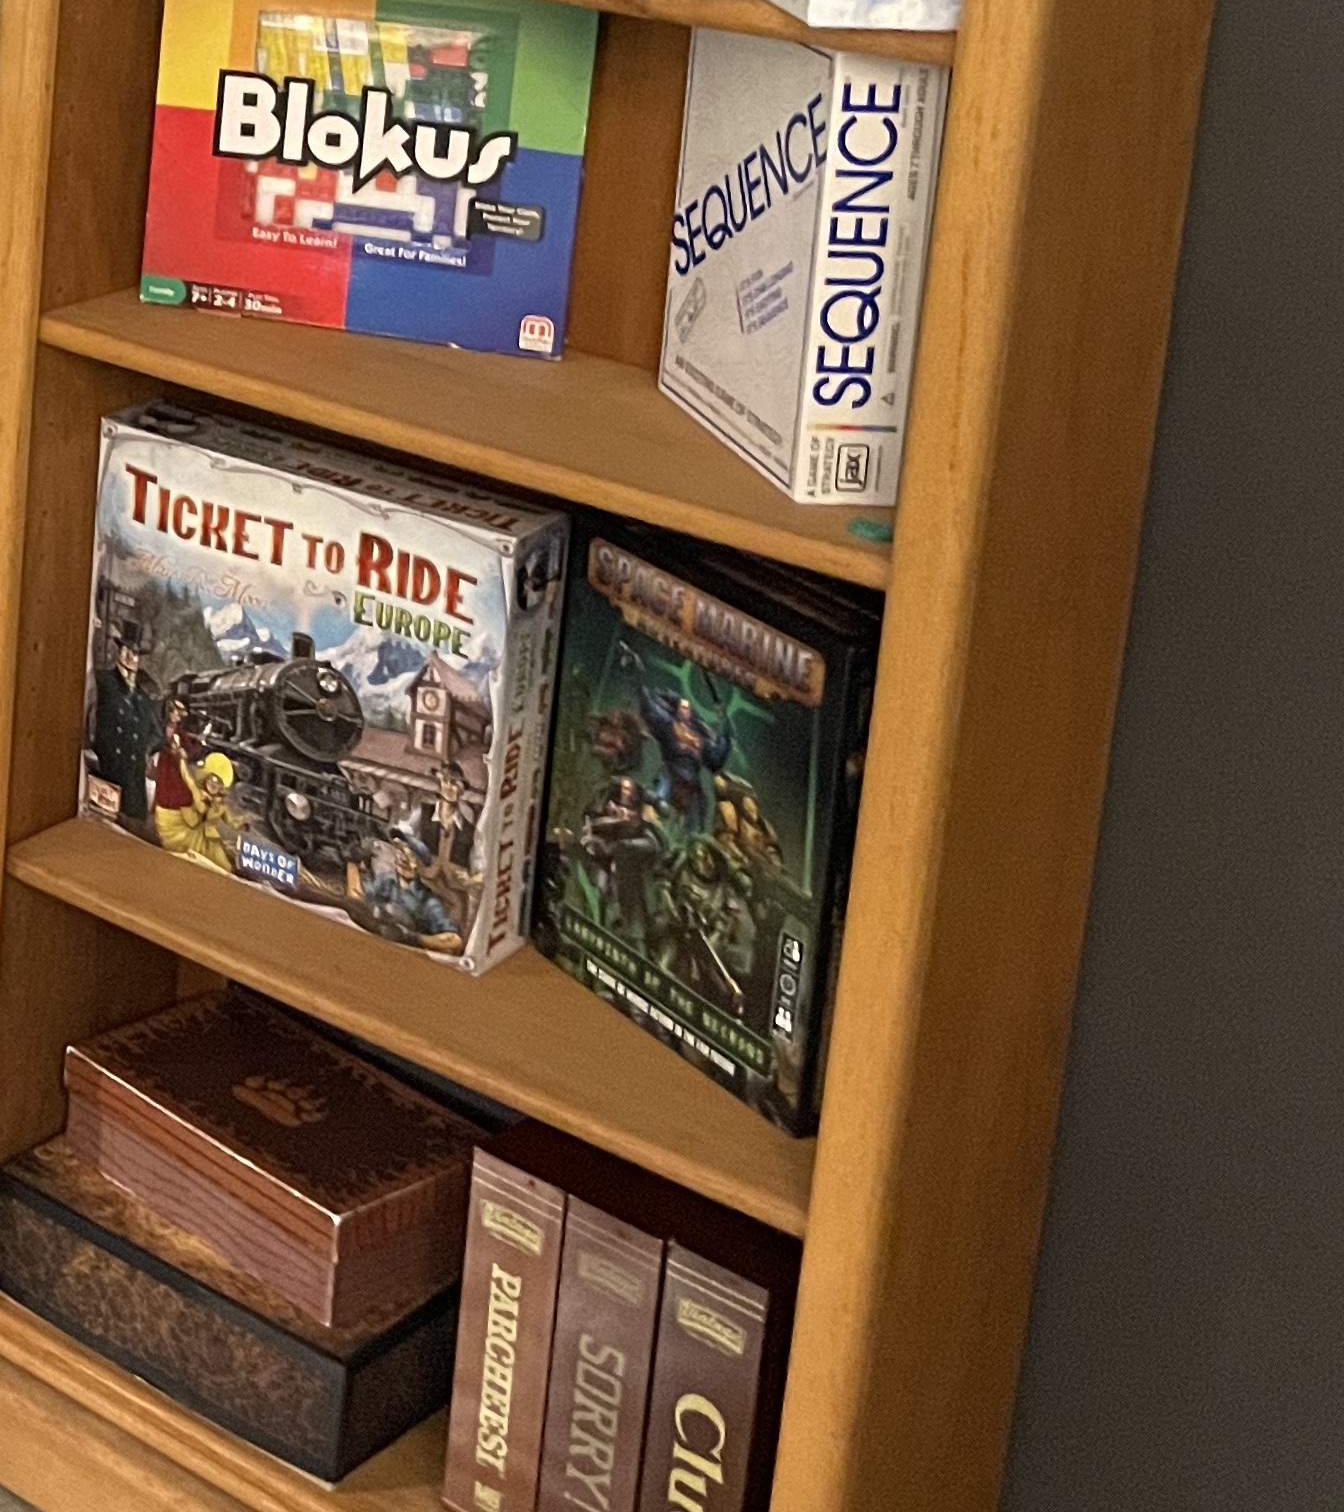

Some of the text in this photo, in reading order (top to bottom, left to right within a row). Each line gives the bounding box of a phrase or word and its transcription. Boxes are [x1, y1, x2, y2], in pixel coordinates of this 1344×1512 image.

[218, 71, 514, 193] Blokus
[670, 92, 829, 277] SEQUENCE
[251, 227, 280, 244] Easy
[363, 242, 397, 258] Great
[418, 250, 468, 268] Families!
[811, 82, 901, 409] SEQUENCE
[213, 294, 237, 309] 2-4
[807, 454, 820, 487] GAME
[839, 452, 863, 487] jax
[123, 462, 480, 625] TICKET TO RIDE
[351, 588, 473, 659] EUROPE
[596, 545, 815, 691] SPACE MARINE
[498, 717, 525, 799] RIDE
[242, 841, 296, 870] DAYS OF
[484, 838, 515, 958] TICKET
[474, 1262, 523, 1479] PARCHEESI
[563, 1333, 627, 1512] SORRY!
